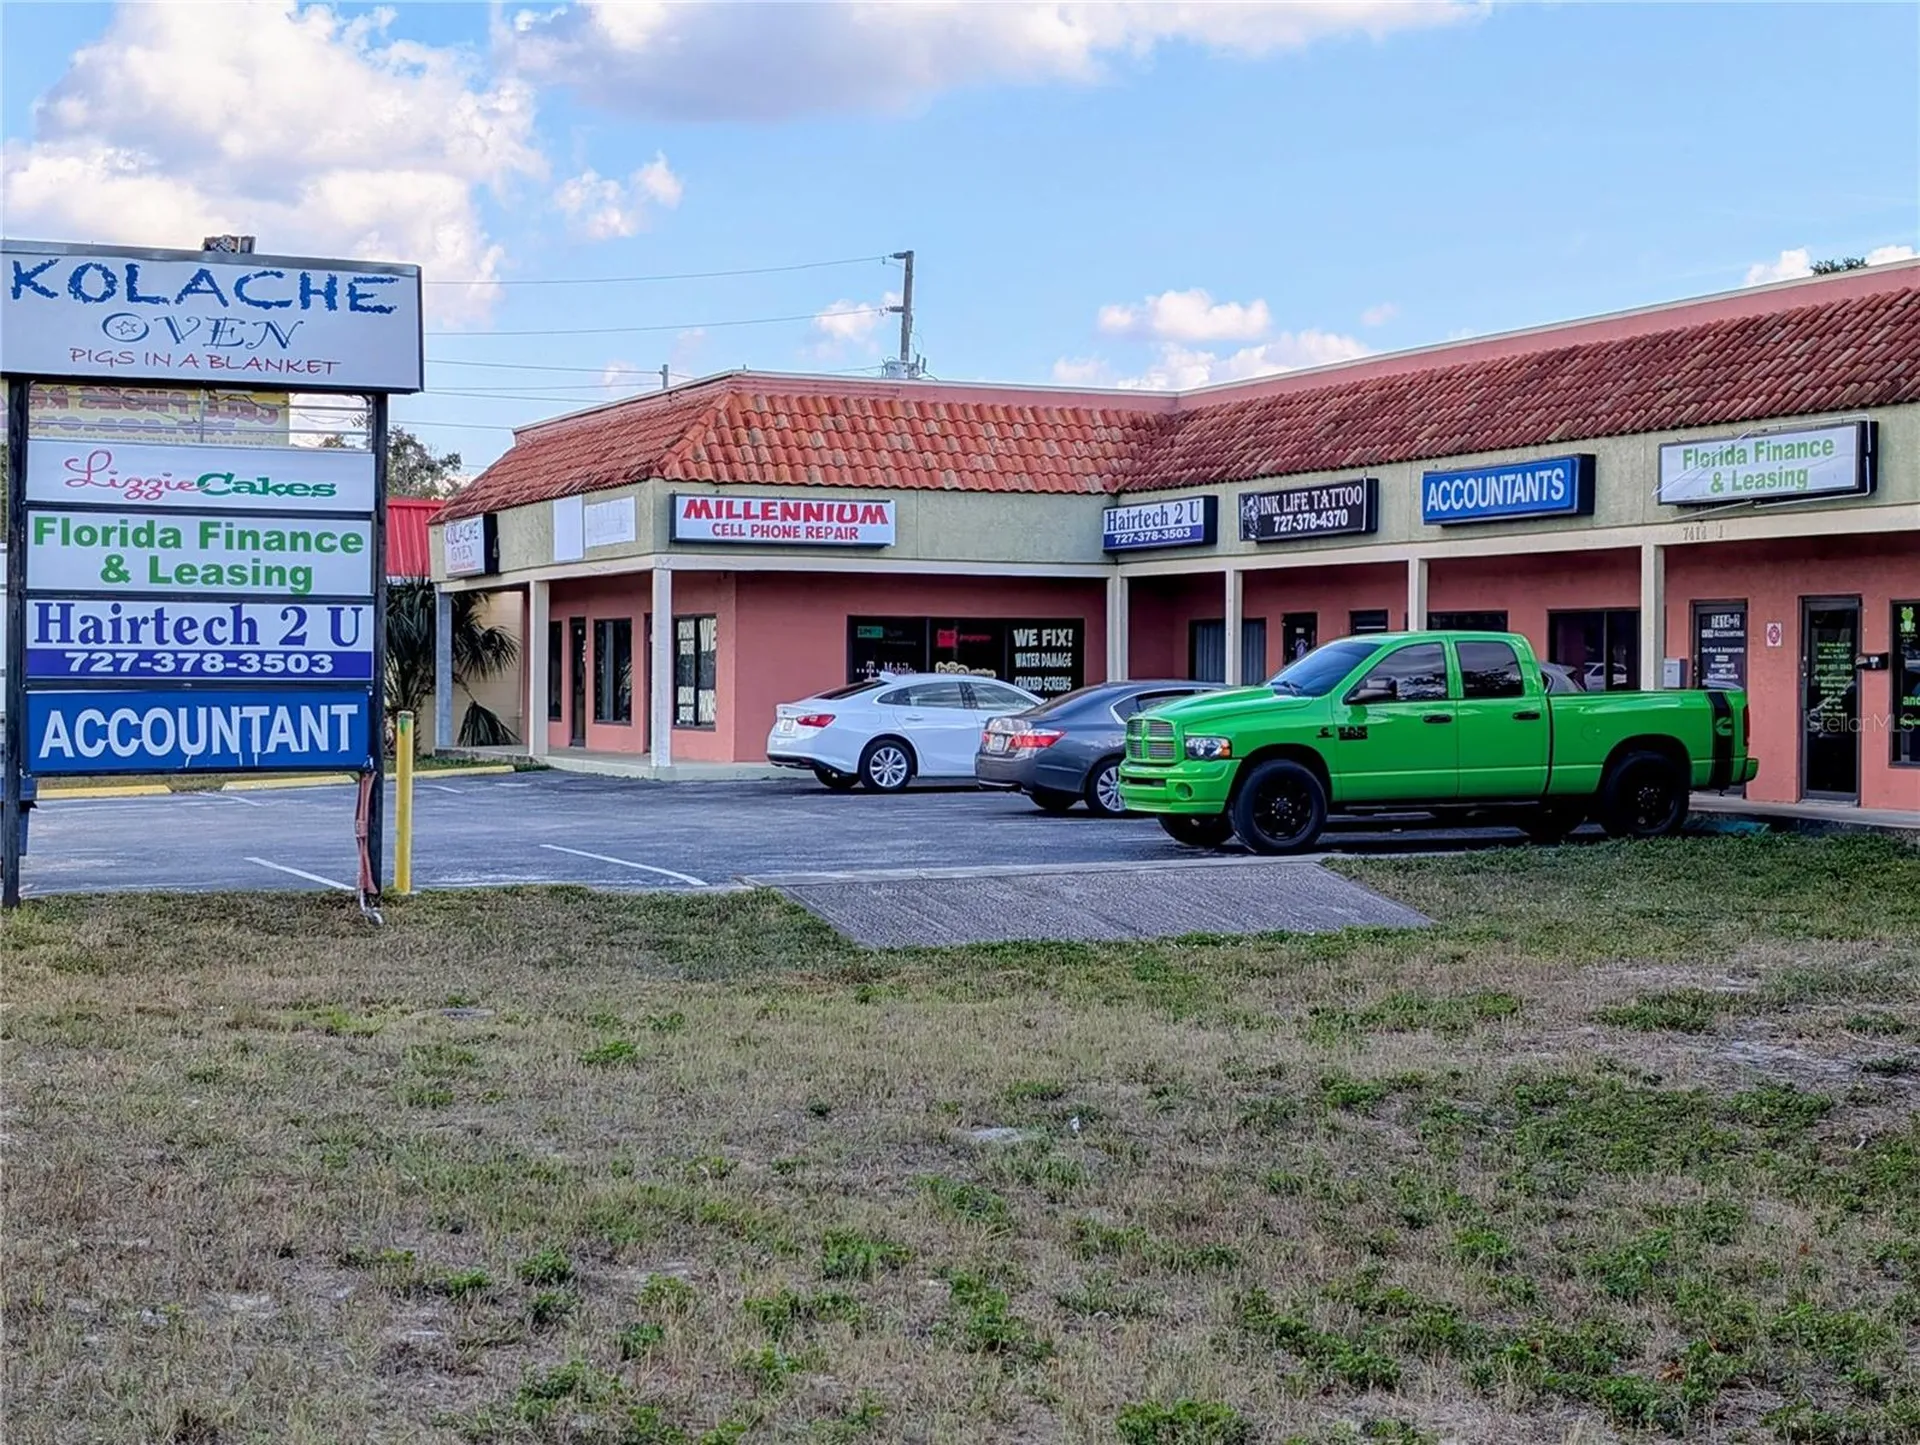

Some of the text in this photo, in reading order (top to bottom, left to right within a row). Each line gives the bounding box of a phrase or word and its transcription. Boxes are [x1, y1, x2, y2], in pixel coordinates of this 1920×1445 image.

[11, 258, 400, 315] KOLACHE
[102, 312, 305, 350] OVEN
[69, 347, 342, 376] PIGS IN A BLANKET
[1682, 436, 1835, 470] Florida Finance
[1426, 467, 1565, 512] ACCOUNTANTS
[1710, 467, 1809, 492] & Leasing
[682, 499, 889, 525] MILLENNIUM
[1259, 484, 1363, 515] INK LIFE TATTOO
[711, 522, 860, 541] CELL PHONE REPAIR
[1106, 500, 1200, 532] Hairtech 2 U
[1272, 508, 1349, 533] 727-378-4370
[33, 516, 364, 553] Florida Finance
[1113, 526, 1192, 544] 727-378-3503
[100, 553, 313, 595] & Leasing
[34, 602, 363, 648] Hairtech 2 U
[1013, 628, 1039, 647] WE
[1042, 628, 1074, 647] FIX!
[65, 651, 334, 674] 727-378-3503
[1015, 652, 1073, 668] WATER DAMAGE
[38, 704, 359, 760] ACCOUNTANT
